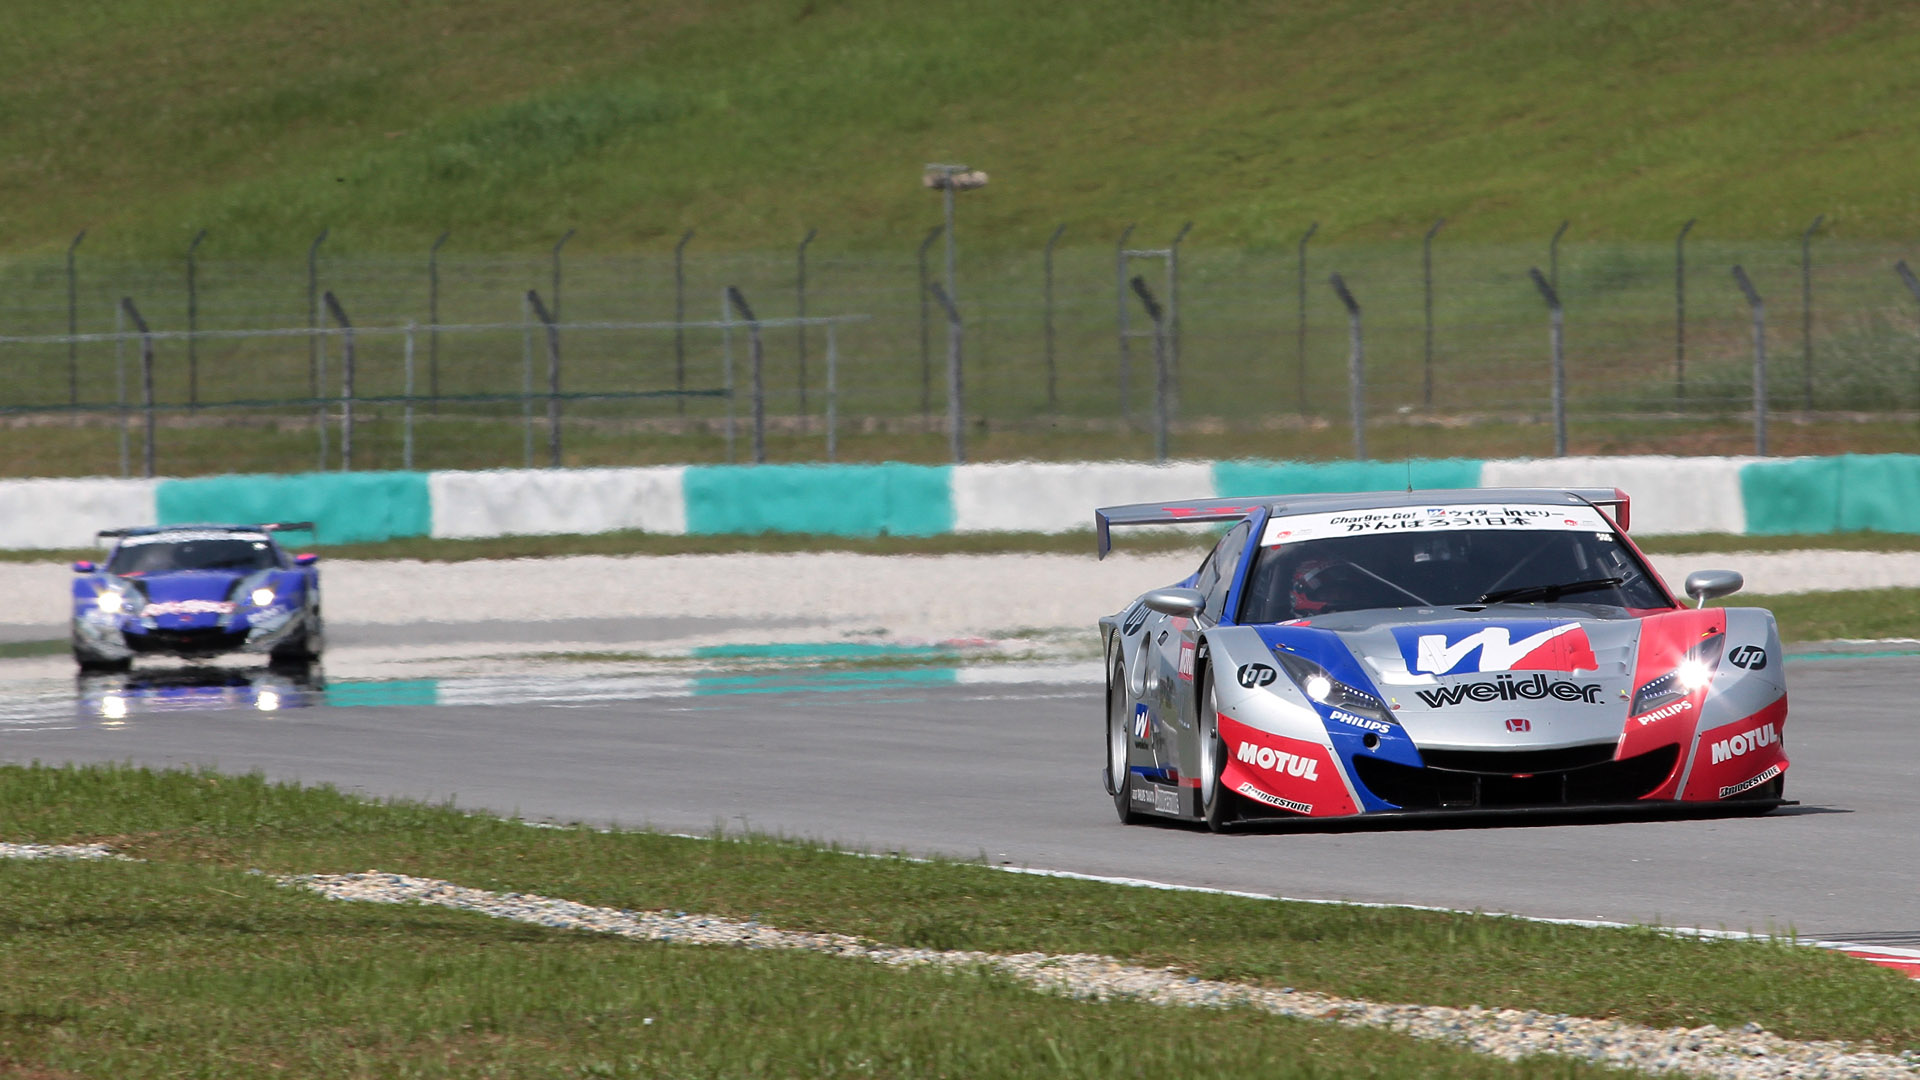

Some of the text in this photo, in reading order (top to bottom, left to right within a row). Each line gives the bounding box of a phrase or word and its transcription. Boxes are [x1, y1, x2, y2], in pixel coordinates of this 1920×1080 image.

[1732, 645, 1764, 670] hp
[1241, 663, 1274, 688] hp
[1329, 710, 1391, 733] PHILIPS
[1638, 700, 1693, 725] PHILIPS
[1711, 722, 1778, 765] MOTUL
[1237, 741, 1318, 782] MOTUL
